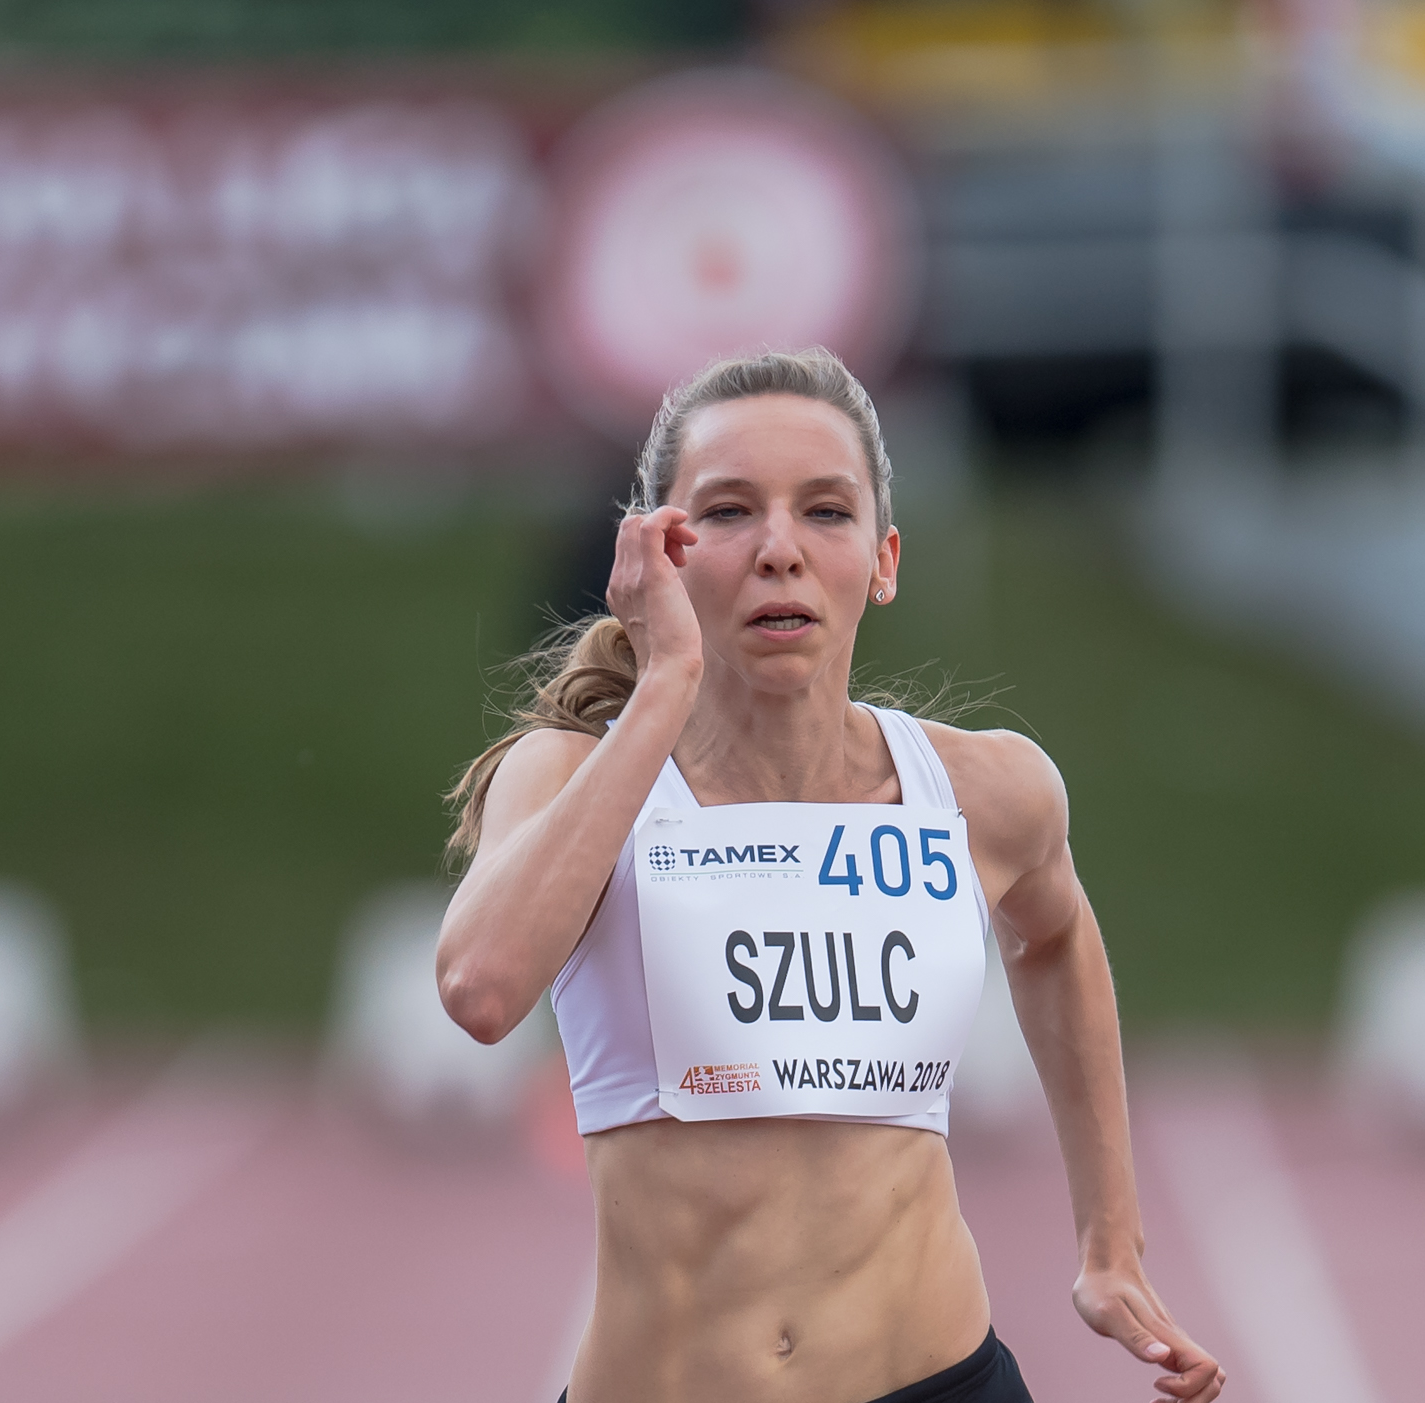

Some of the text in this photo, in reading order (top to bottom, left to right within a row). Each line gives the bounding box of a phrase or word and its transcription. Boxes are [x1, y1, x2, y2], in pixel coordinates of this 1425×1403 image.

[680, 845, 801, 866] TAMEX
[818, 824, 958, 900] 405
[725, 930, 919, 1024] SZULC
[696, 1080, 761, 1095] SZELESTA
[715, 1072, 760, 1081] ZYGMUNTA
[772, 1058, 950, 1092] WARSZAWA 2018
